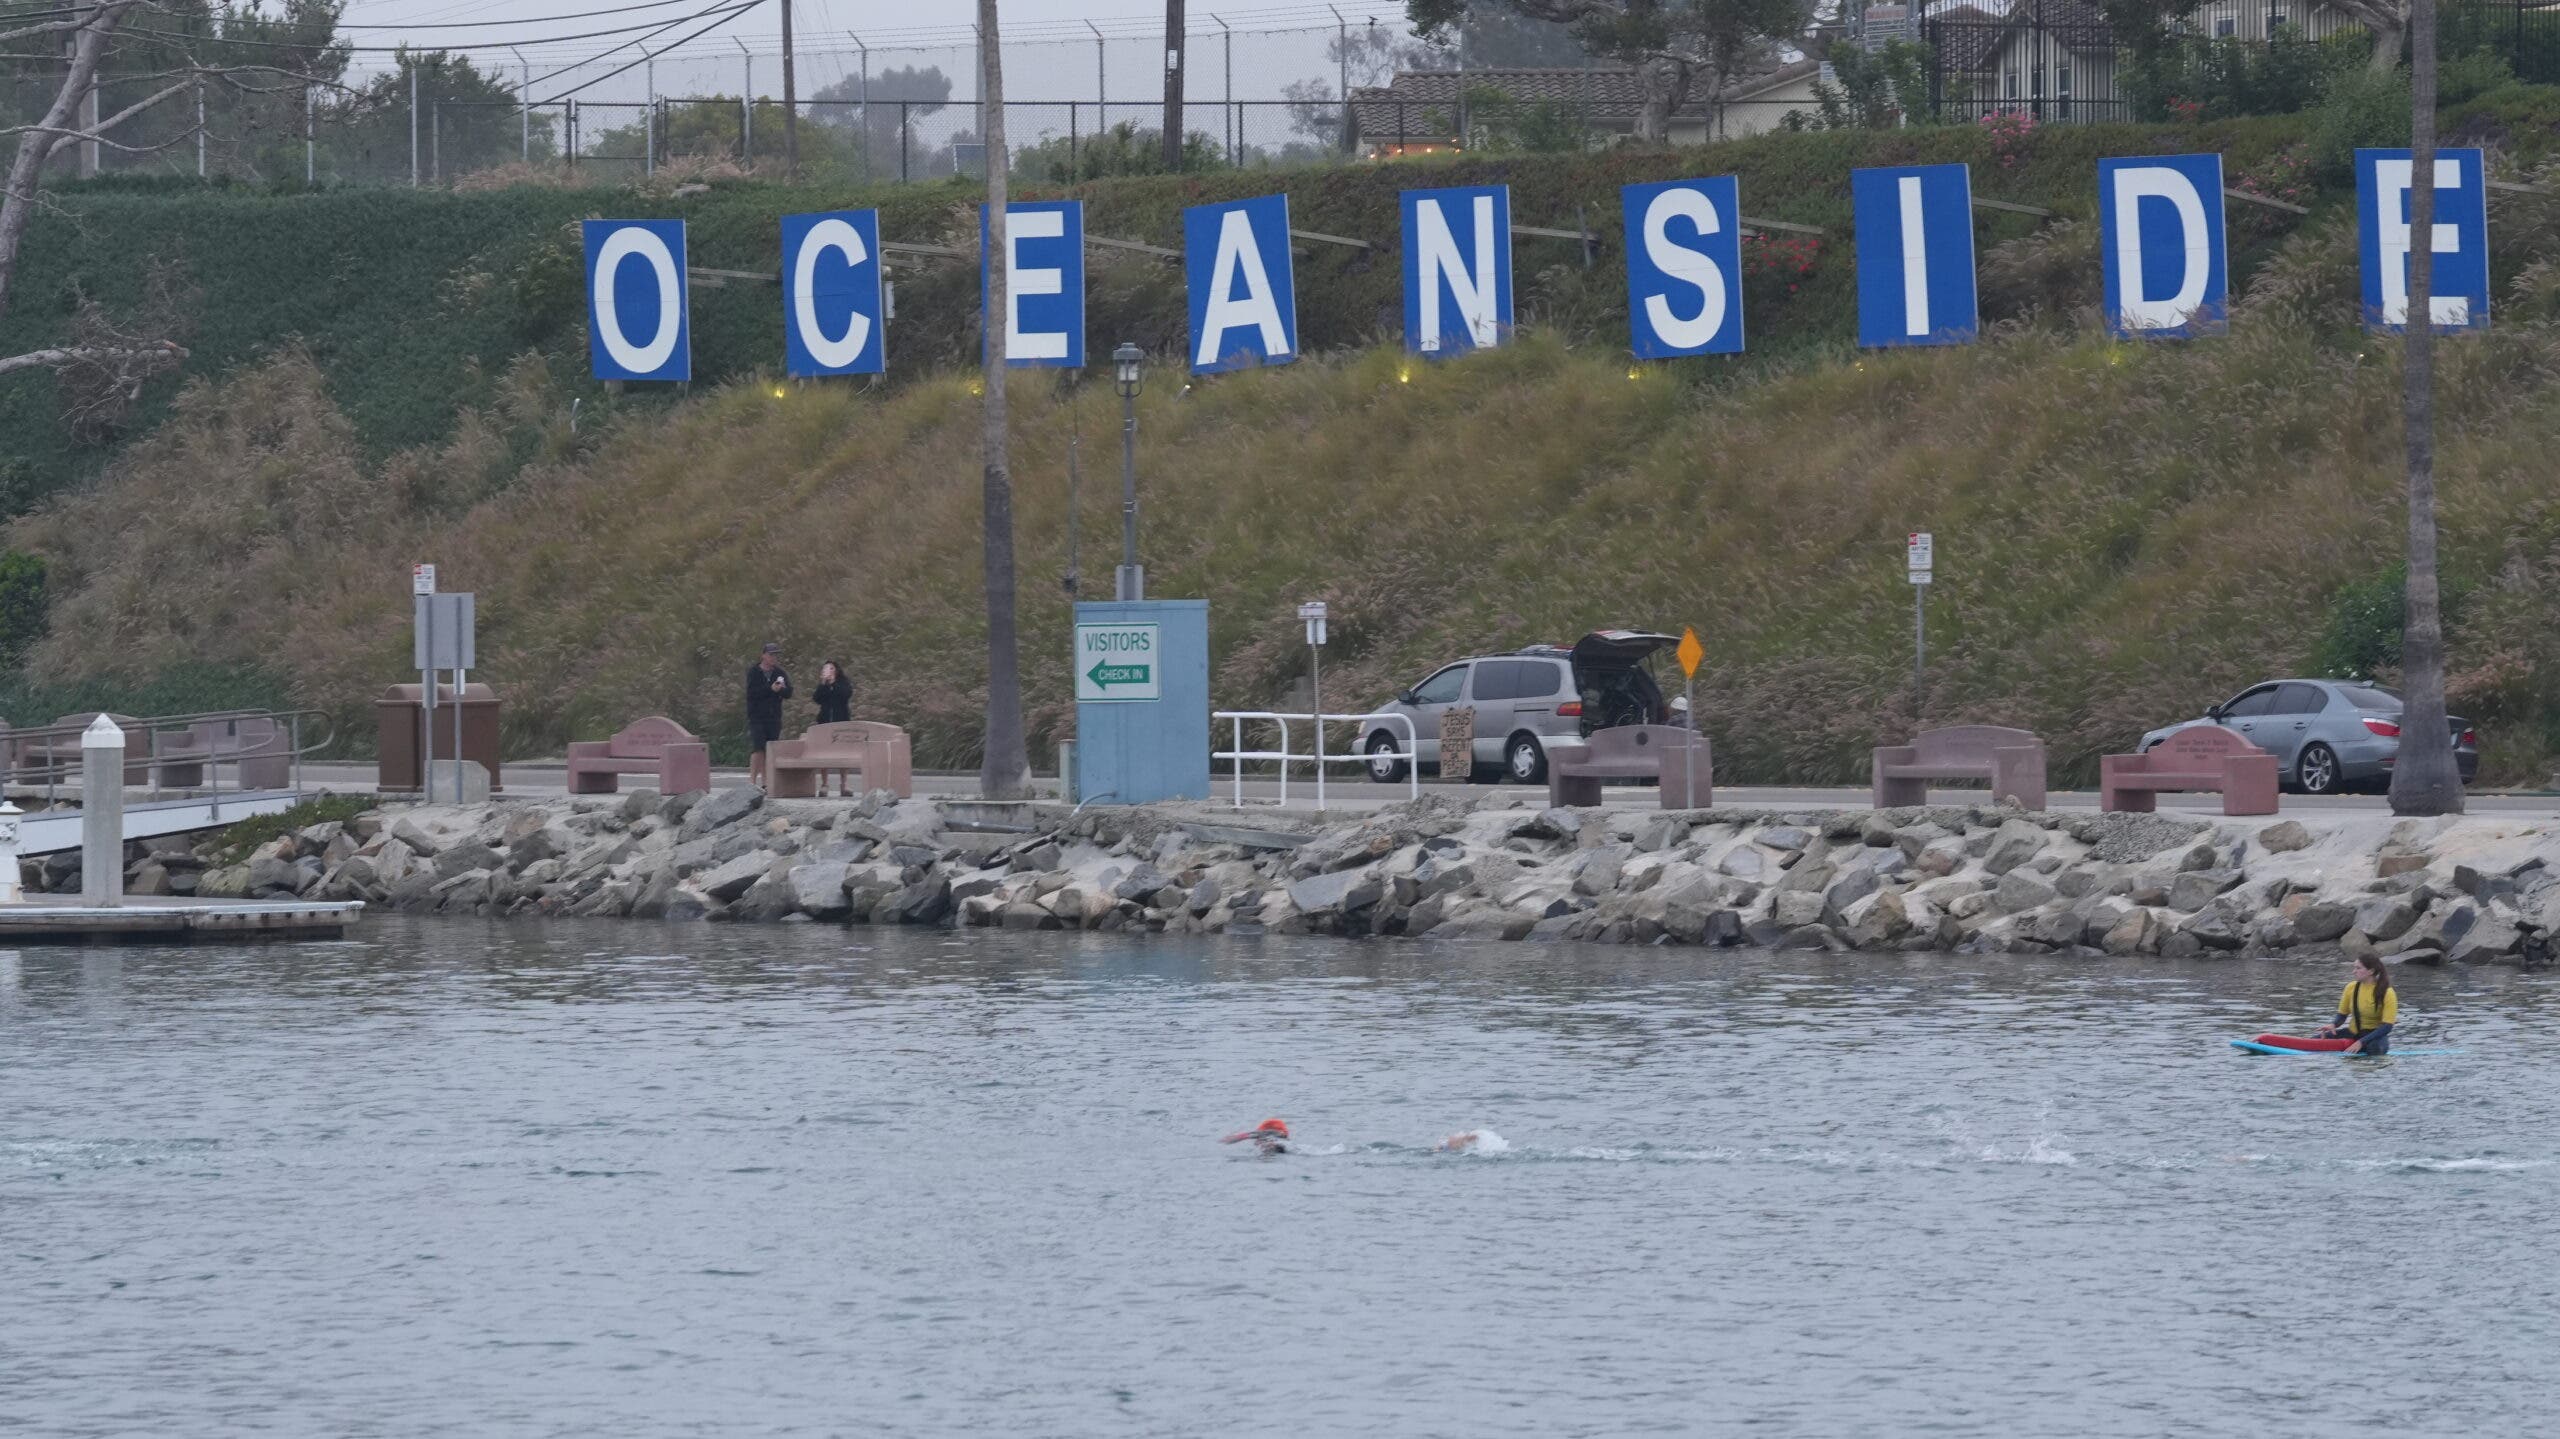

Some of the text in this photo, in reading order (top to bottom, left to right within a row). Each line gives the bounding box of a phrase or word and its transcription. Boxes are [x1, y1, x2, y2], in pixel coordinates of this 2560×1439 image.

[1086, 632, 1150, 651] VISITORS
[1098, 669, 1143, 680] CHECK IN
[1443, 712, 1470, 726] JESUS
[1446, 727, 1465, 737] SAYS
